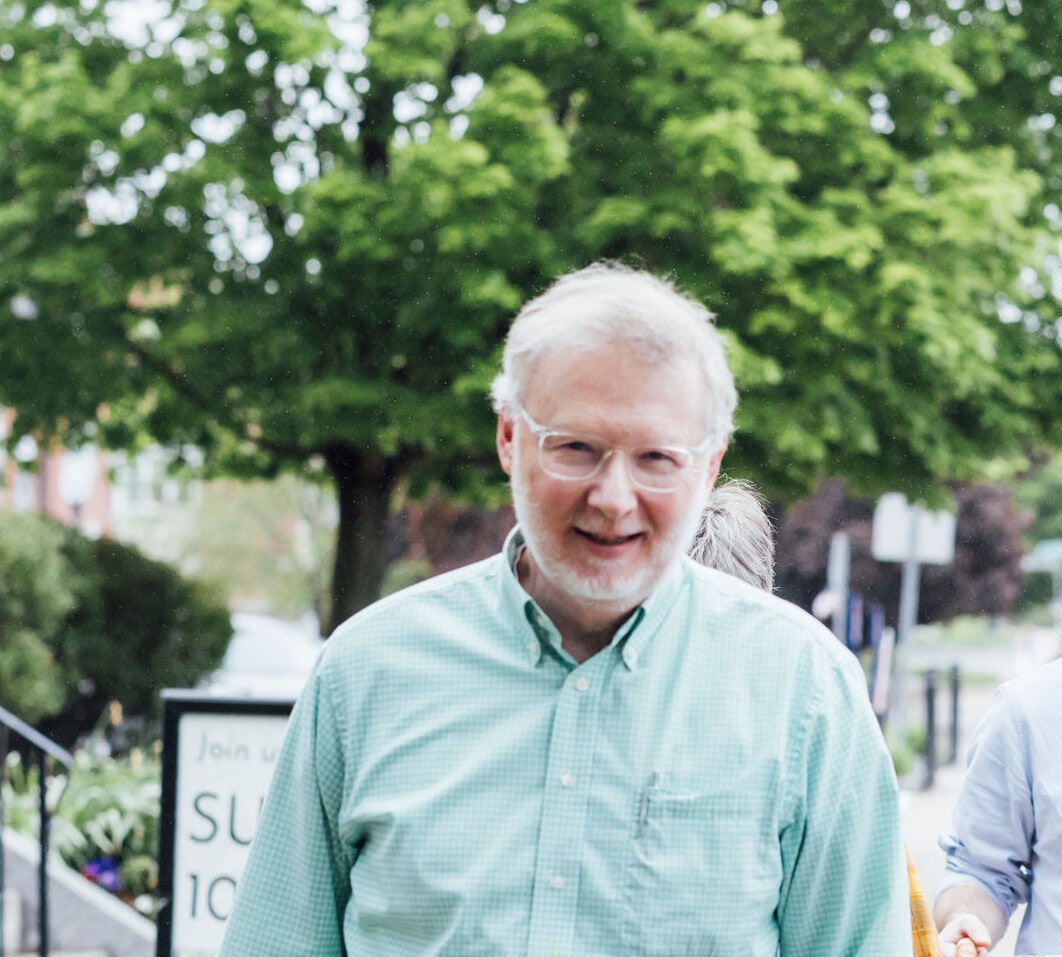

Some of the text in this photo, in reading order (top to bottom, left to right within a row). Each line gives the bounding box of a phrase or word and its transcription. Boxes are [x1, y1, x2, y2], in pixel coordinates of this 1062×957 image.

[197, 733, 277, 762] Join u
[189, 792, 265, 846] SU
